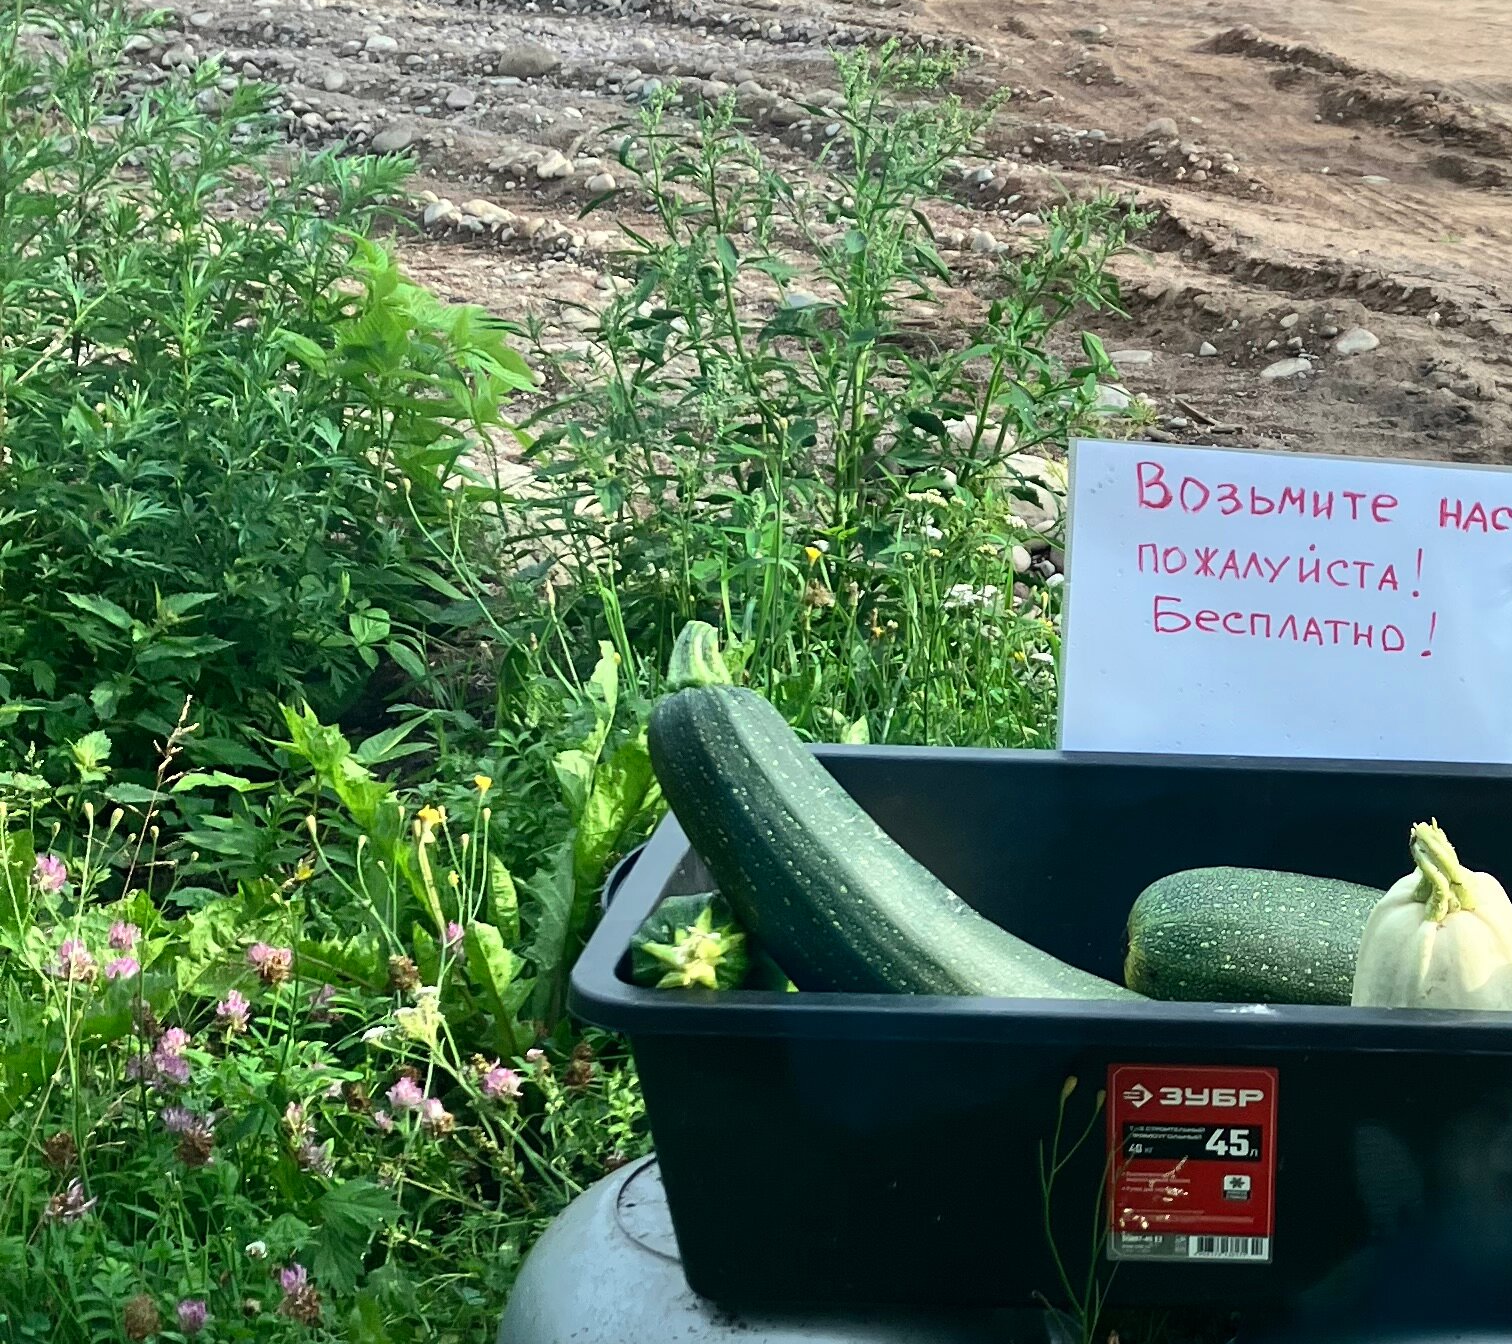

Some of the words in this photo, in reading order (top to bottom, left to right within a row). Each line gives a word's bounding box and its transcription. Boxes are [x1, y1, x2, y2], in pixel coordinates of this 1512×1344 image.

[1136, 461, 1399, 524] Возьмите
[1159, 1087, 1265, 1107] ЗУБР
[1205, 1128, 1250, 1156] 45
